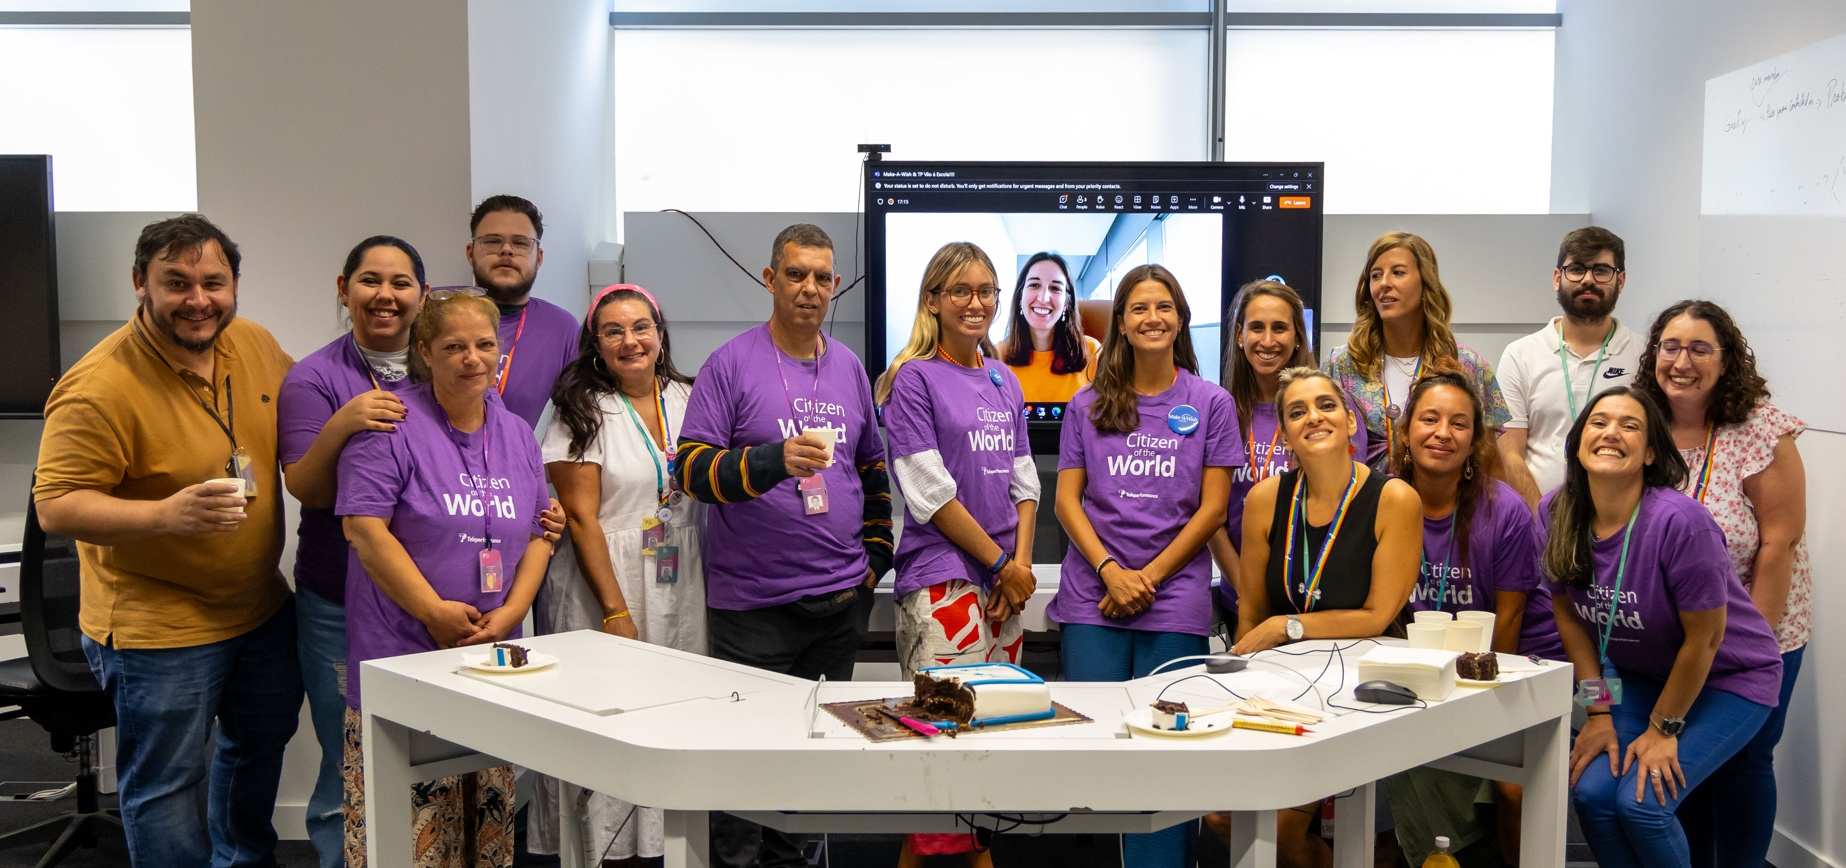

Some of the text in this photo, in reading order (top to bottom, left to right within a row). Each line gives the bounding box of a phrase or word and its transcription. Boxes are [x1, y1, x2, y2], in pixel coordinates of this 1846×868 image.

[1607, 367, 1626, 375] NIKE
[976, 406, 1013, 422] Citizen
[968, 428, 1014, 452] World
[1126, 433, 1178, 450] Citizen
[1133, 449, 1156, 457] of the
[1107, 454, 1176, 478] World
